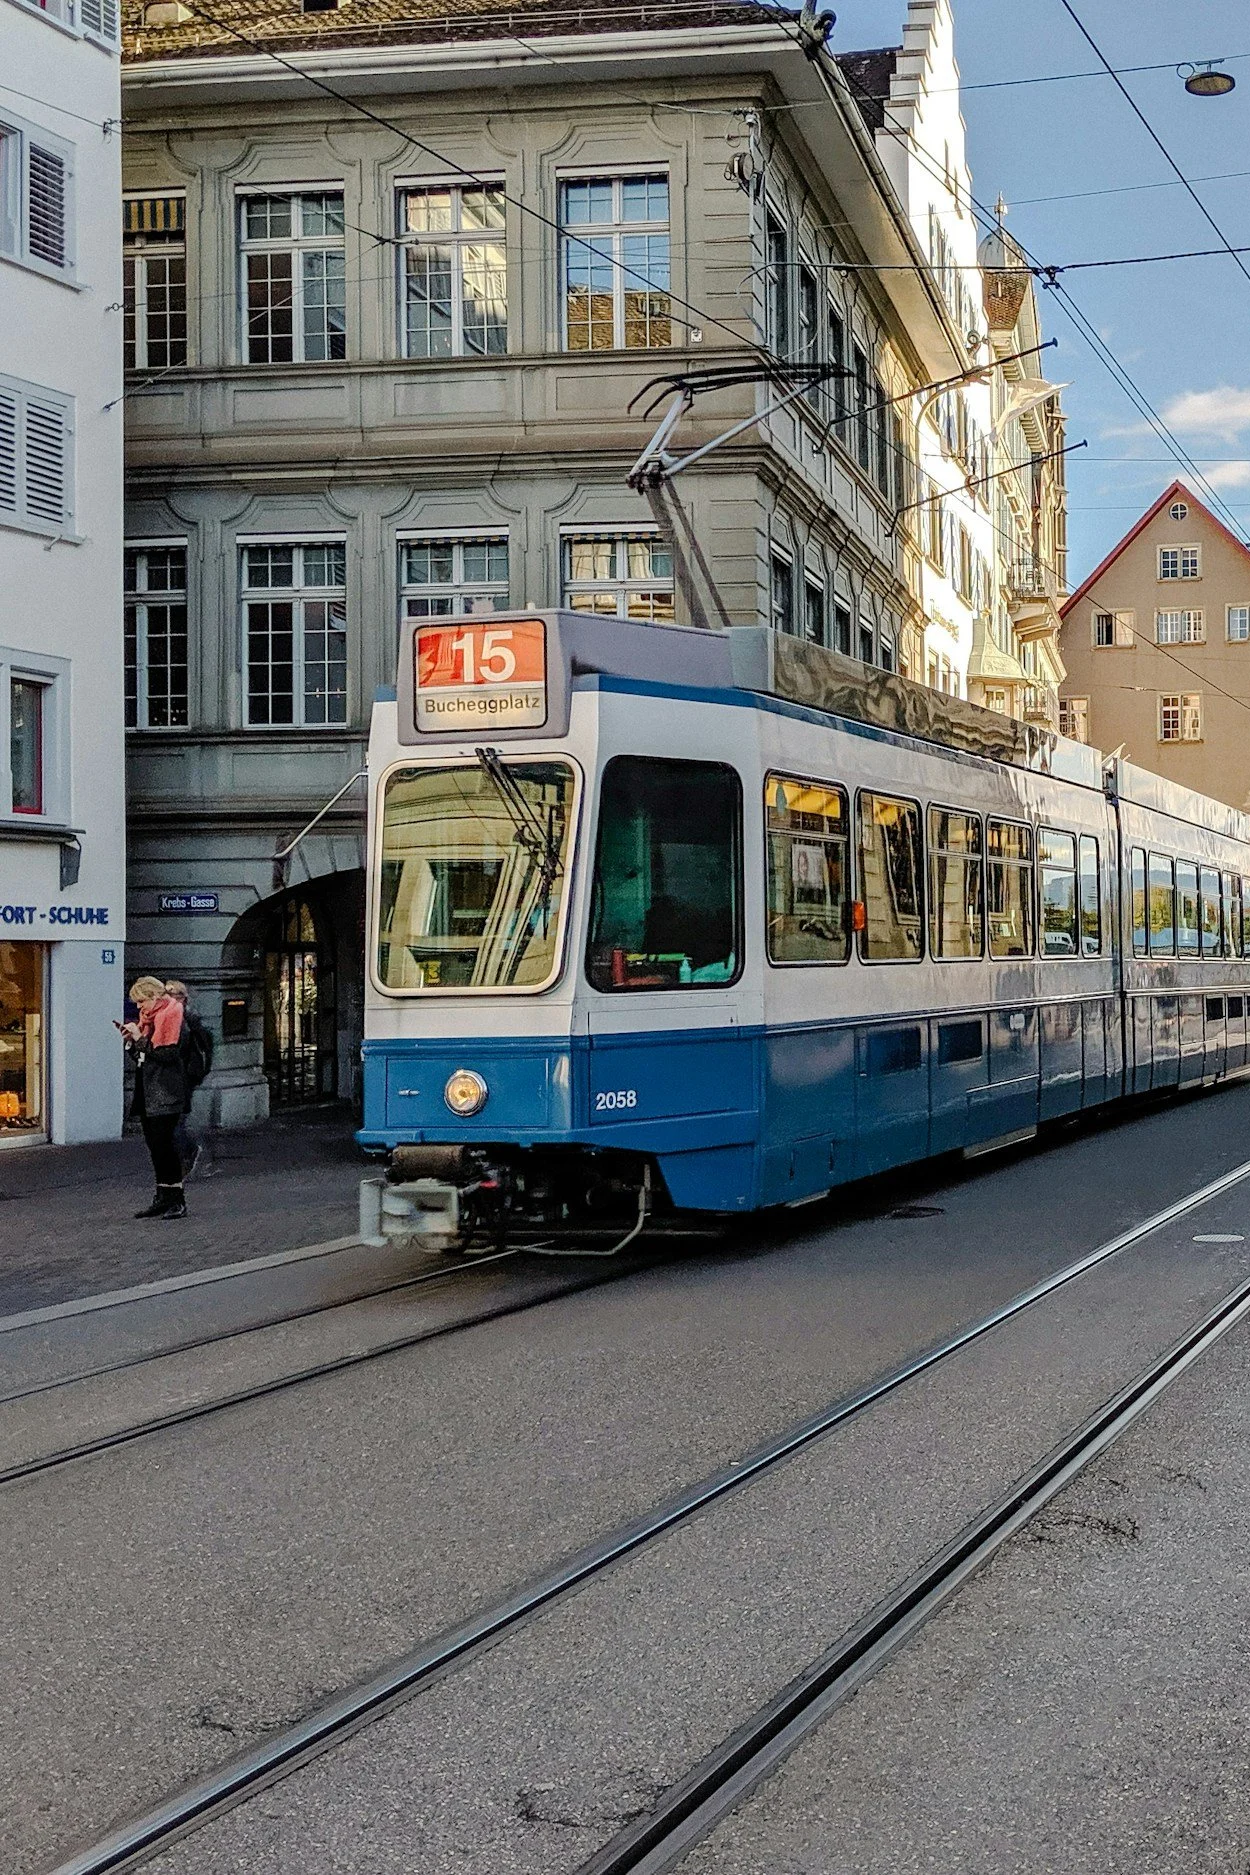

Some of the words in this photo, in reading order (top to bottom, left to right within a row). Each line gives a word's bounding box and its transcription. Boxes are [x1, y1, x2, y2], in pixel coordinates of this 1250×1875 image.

[452, 630, 516, 682] 15
[425, 694, 540, 714] Bucheggplatz
[162, 896, 215, 908] Krebs-Gasse
[49, 906, 109, 925] SCHUHE
[595, 1089, 637, 1110] 2058
